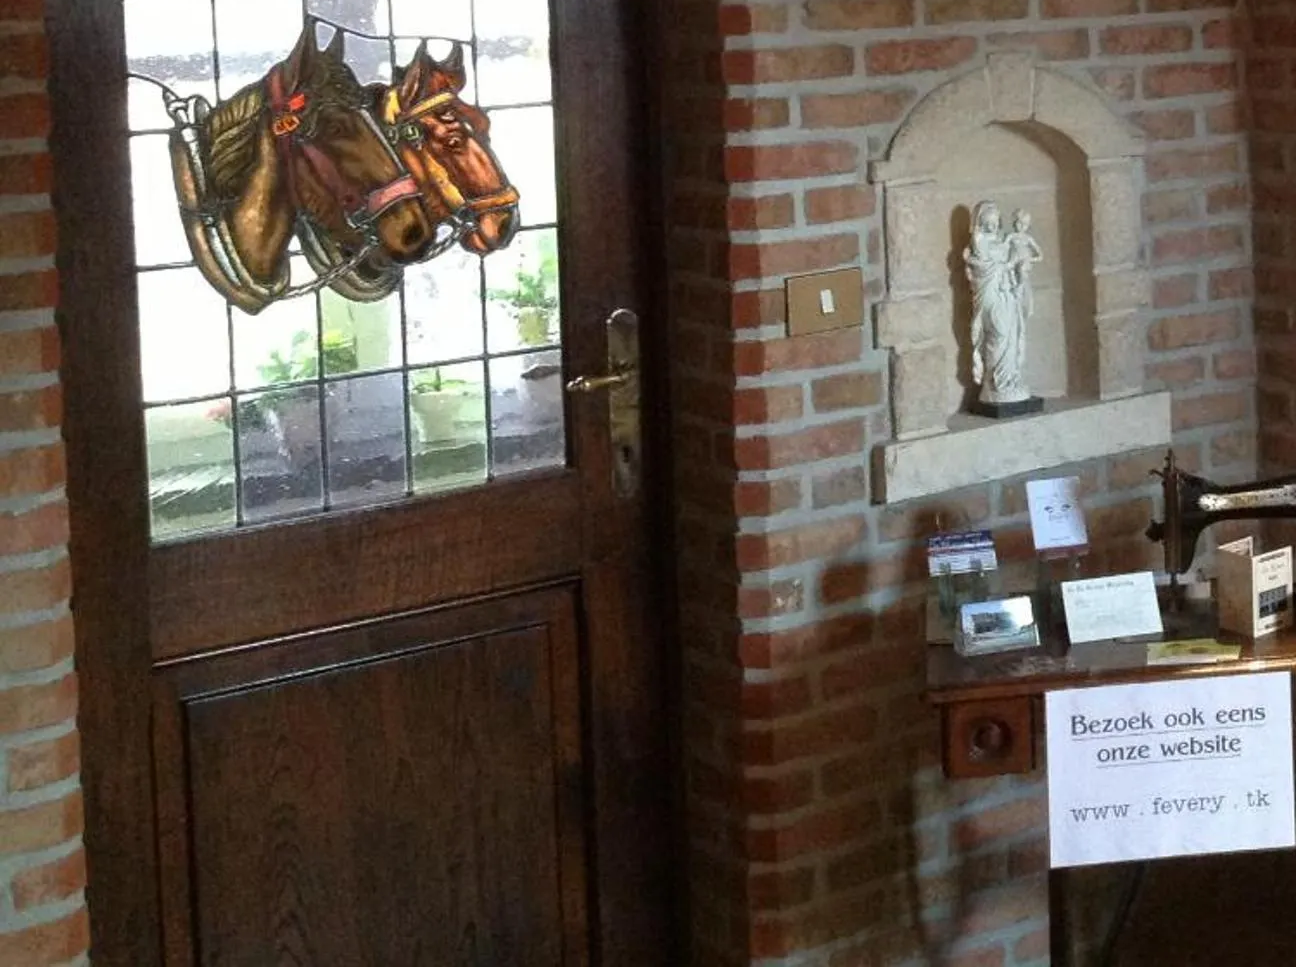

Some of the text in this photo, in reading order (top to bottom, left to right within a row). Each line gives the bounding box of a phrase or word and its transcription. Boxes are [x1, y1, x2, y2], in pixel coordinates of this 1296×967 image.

[1071, 705, 1266, 736] Bezoek ook eens
[1097, 735, 1241, 762] onze website
